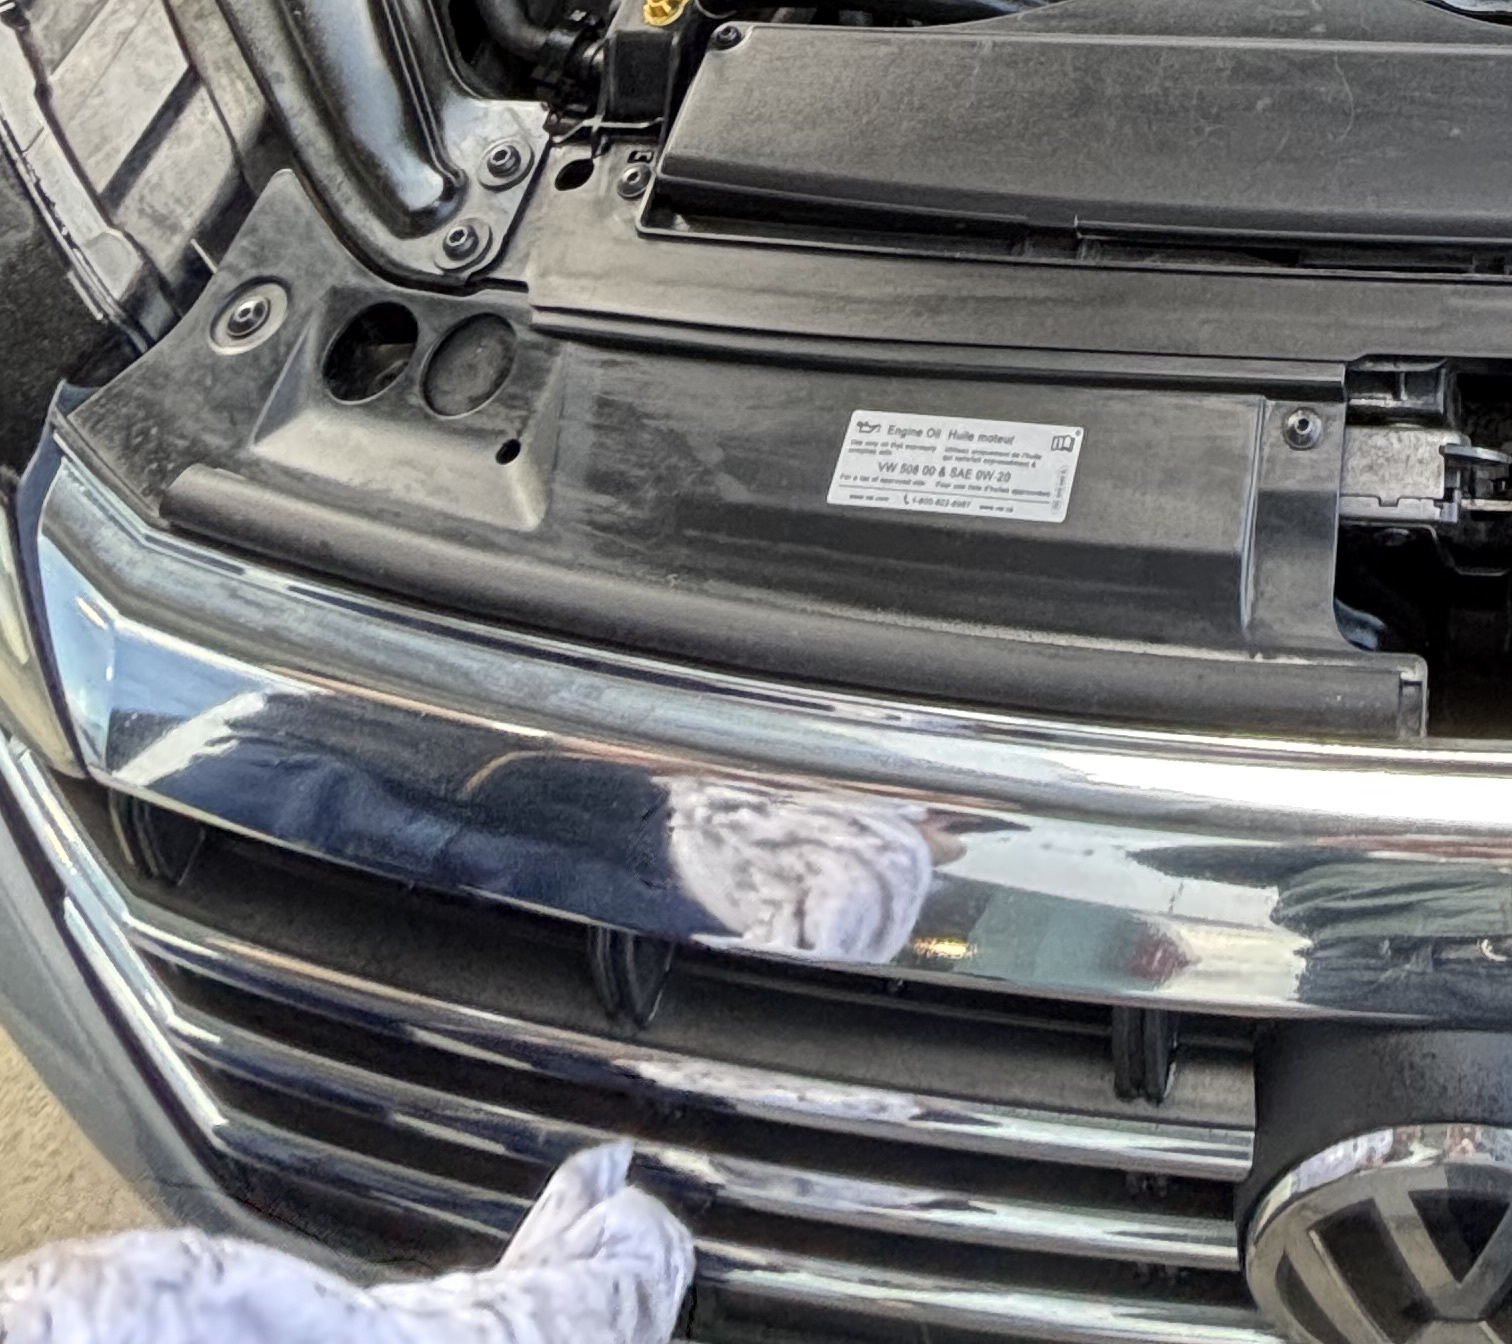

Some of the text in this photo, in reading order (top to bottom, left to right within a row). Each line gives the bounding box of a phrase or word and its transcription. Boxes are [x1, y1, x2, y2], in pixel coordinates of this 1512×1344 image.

[887, 424, 941, 440] Engine Oil
[948, 429, 1015, 446] Huile moteur
[878, 461, 898, 473] VW
[899, 462, 919, 475] 508
[921, 464, 937, 476] 00
[938, 465, 946, 477] &
[949, 466, 972, 480] SAE
